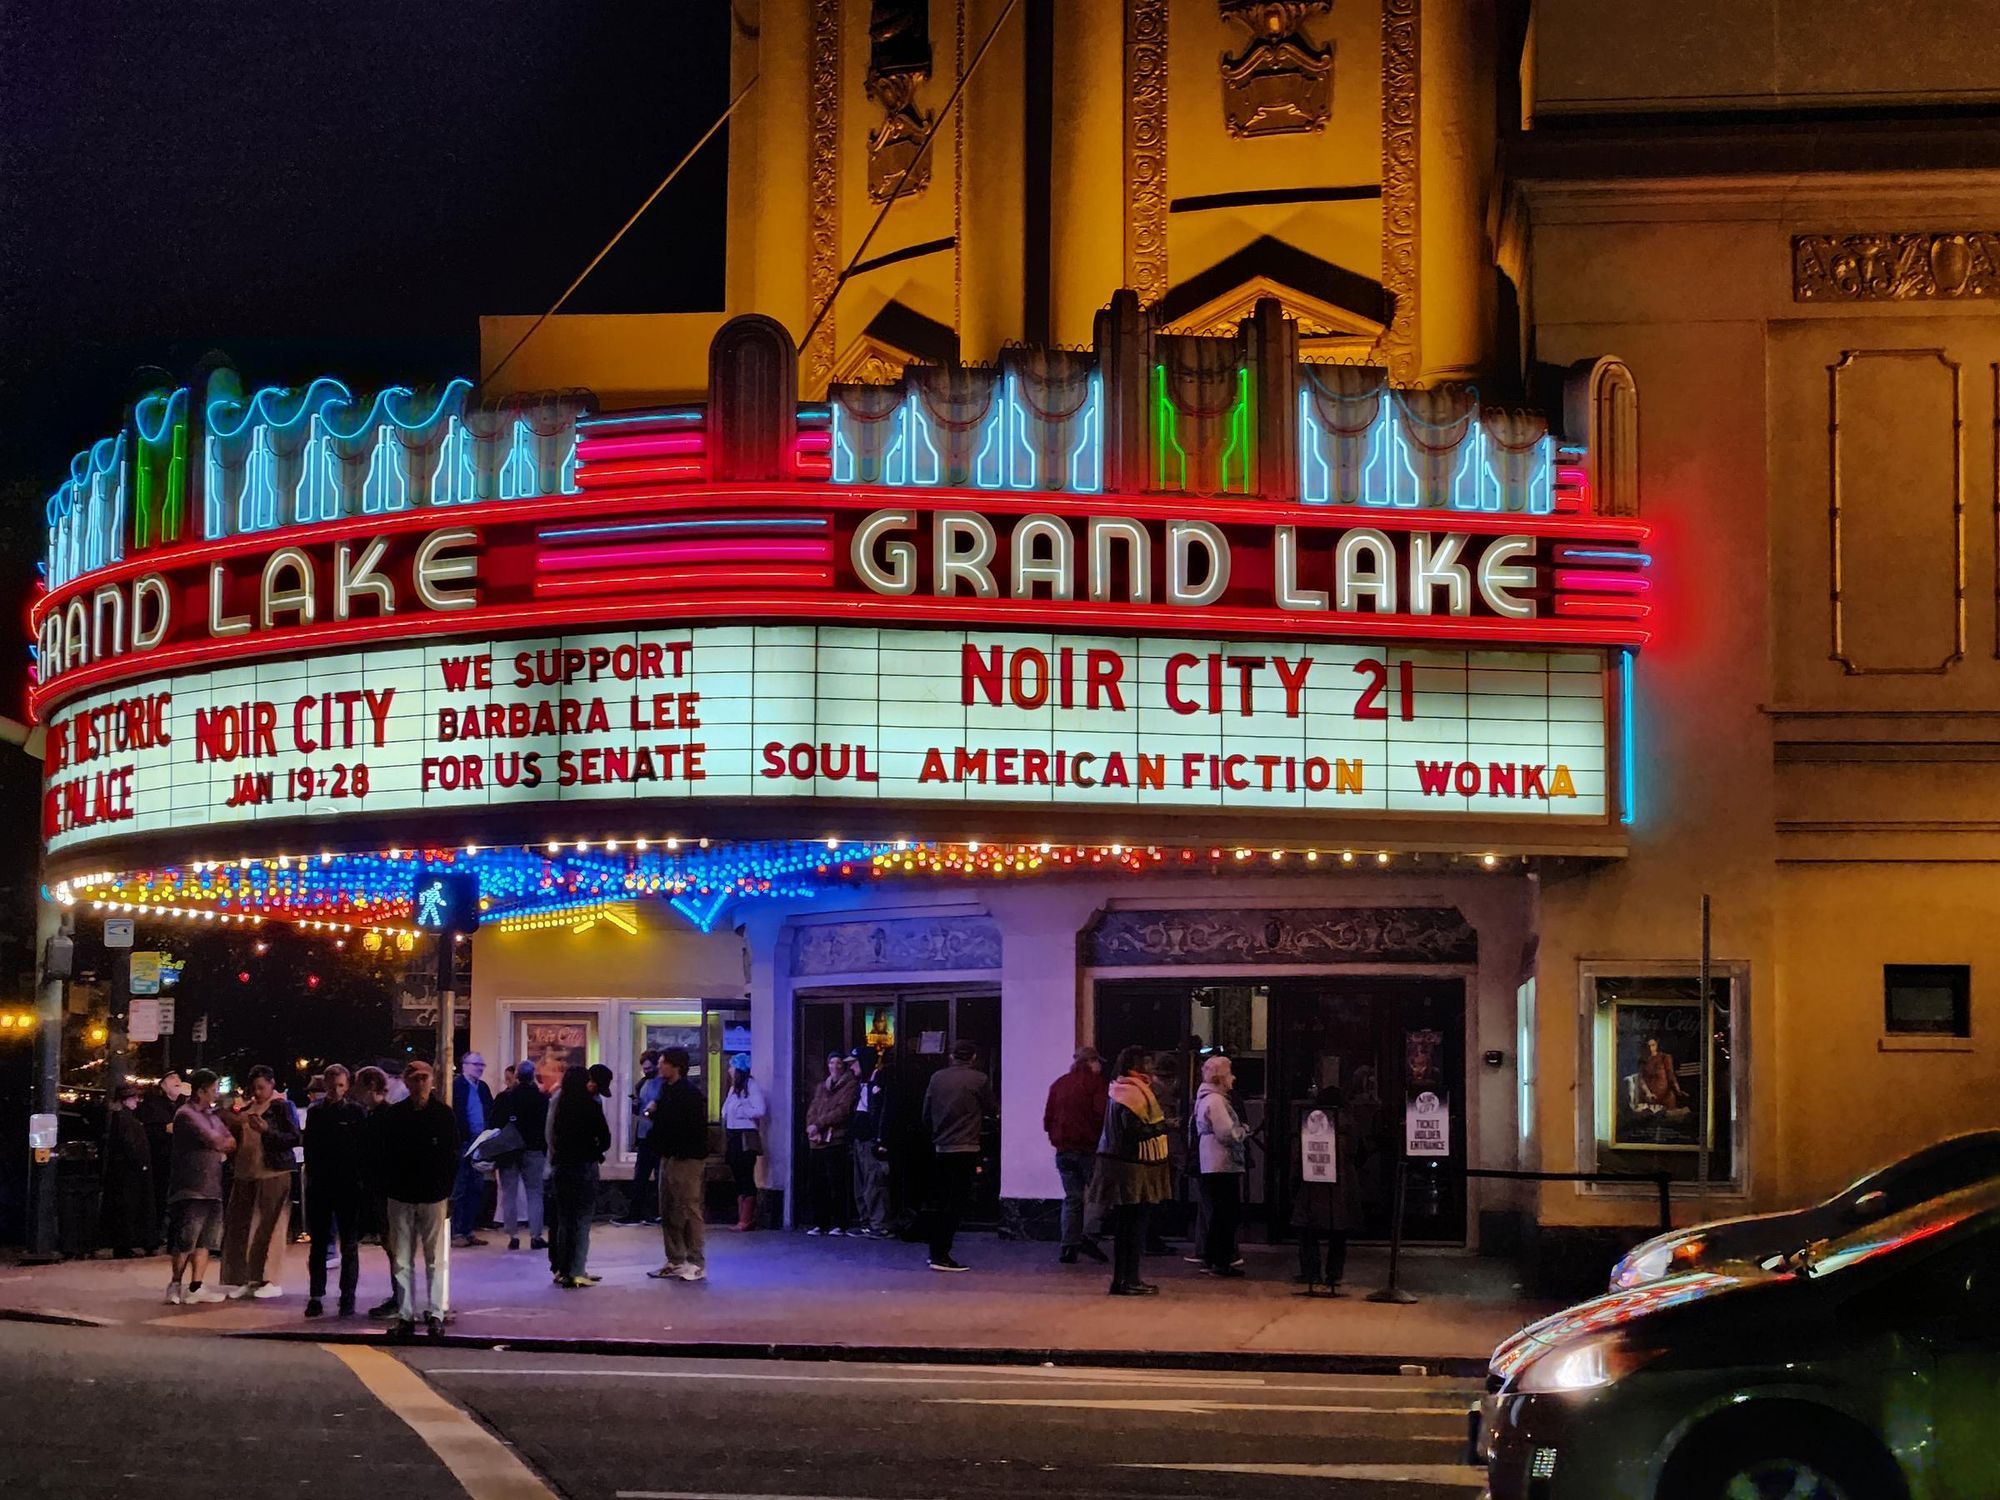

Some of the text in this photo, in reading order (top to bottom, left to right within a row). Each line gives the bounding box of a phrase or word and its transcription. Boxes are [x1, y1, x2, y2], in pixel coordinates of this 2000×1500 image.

[850, 508, 1537, 619] GRAND LAKE
[36, 526, 478, 686] GRAND LAKE
[441, 641, 693, 692] WE SUPPORT
[961, 644, 1414, 722] NOIR CITY 21
[195, 688, 396, 763] NOIR CITY
[438, 692, 701, 742] BARBARA LEE
[421, 742, 706, 792] FOR US SENATE
[760, 742, 879, 783] SOUL
[918, 747, 1363, 794] AMERICAN FICTION
[1416, 759, 1577, 800] WONKA
[226, 771, 273, 807] JAN
[416, 1012, 467, 1027] CAE
[1414, 1130, 1441, 1140] HOLDER
[1416, 1119, 1440, 1129] TICKET
